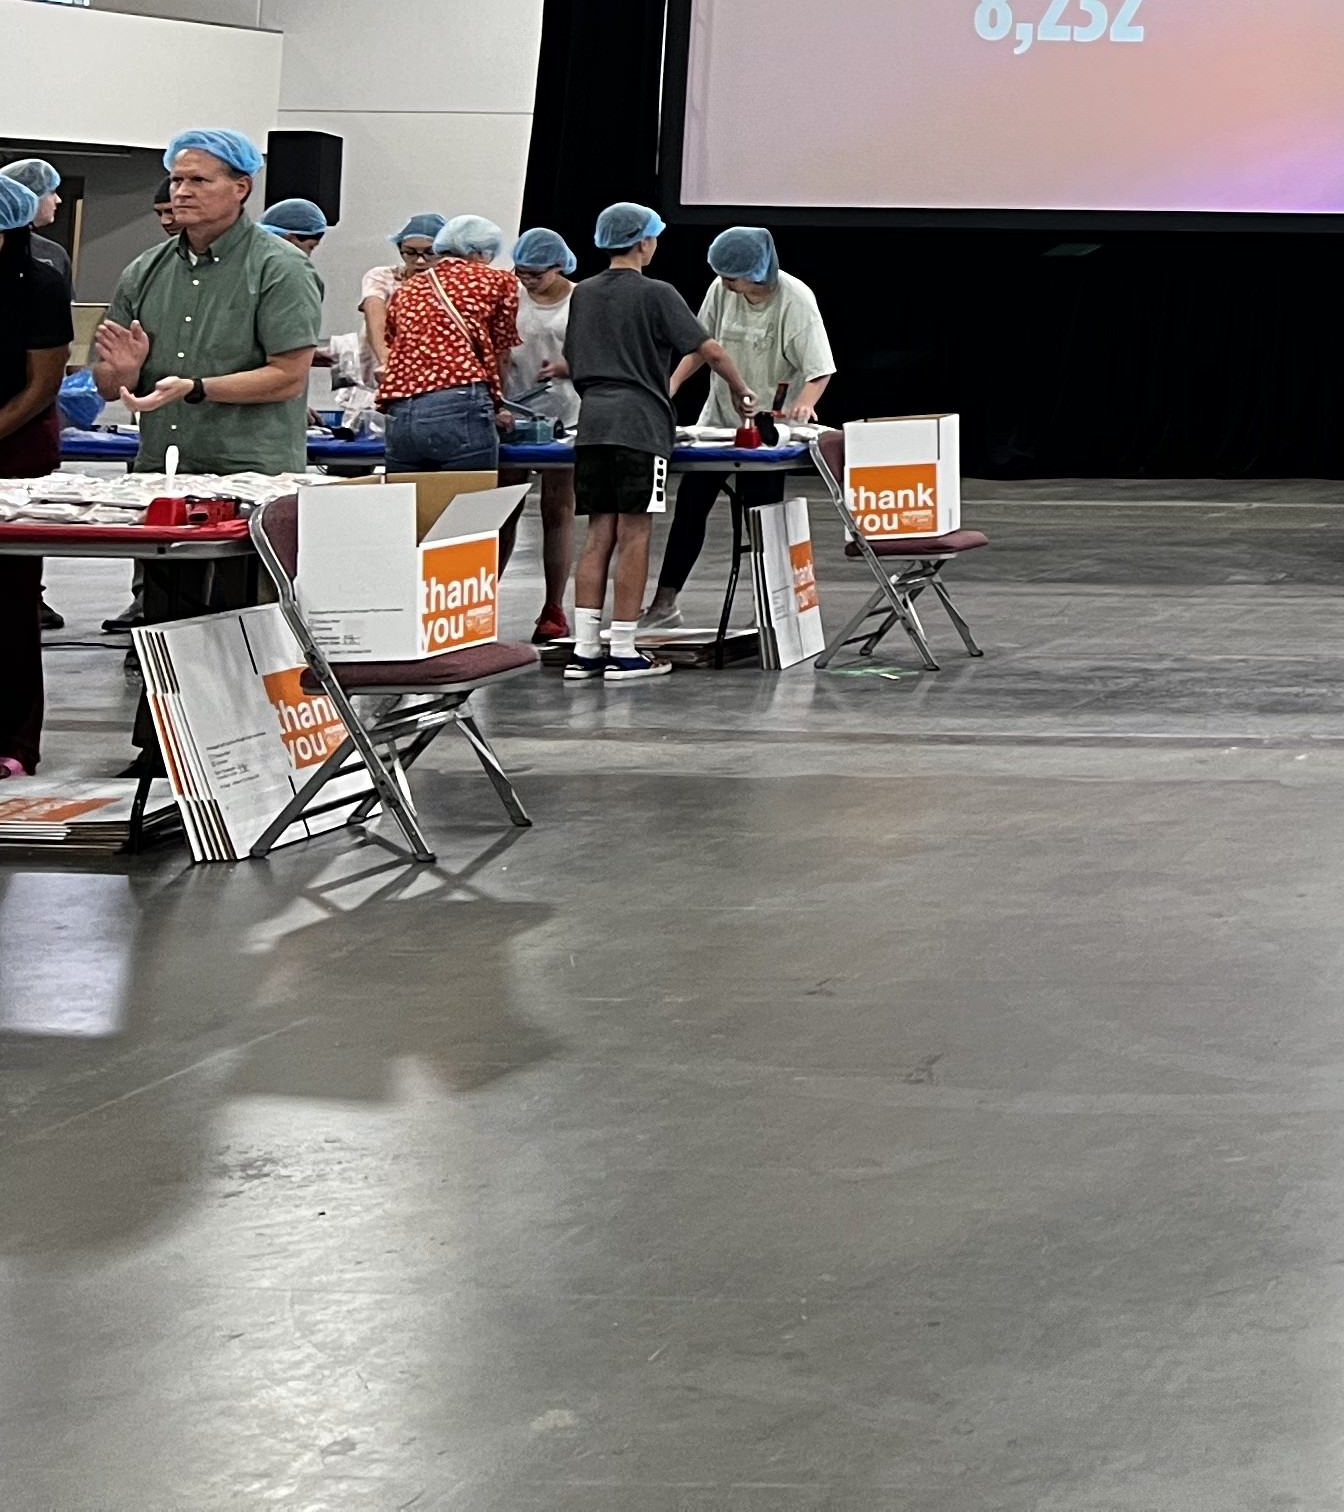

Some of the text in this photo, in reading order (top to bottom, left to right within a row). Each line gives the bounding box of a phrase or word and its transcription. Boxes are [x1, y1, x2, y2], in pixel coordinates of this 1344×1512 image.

[847, 482, 935, 511] thank
[421, 566, 496, 614] thank
[420, 613, 465, 653] you
[272, 696, 339, 735] than
